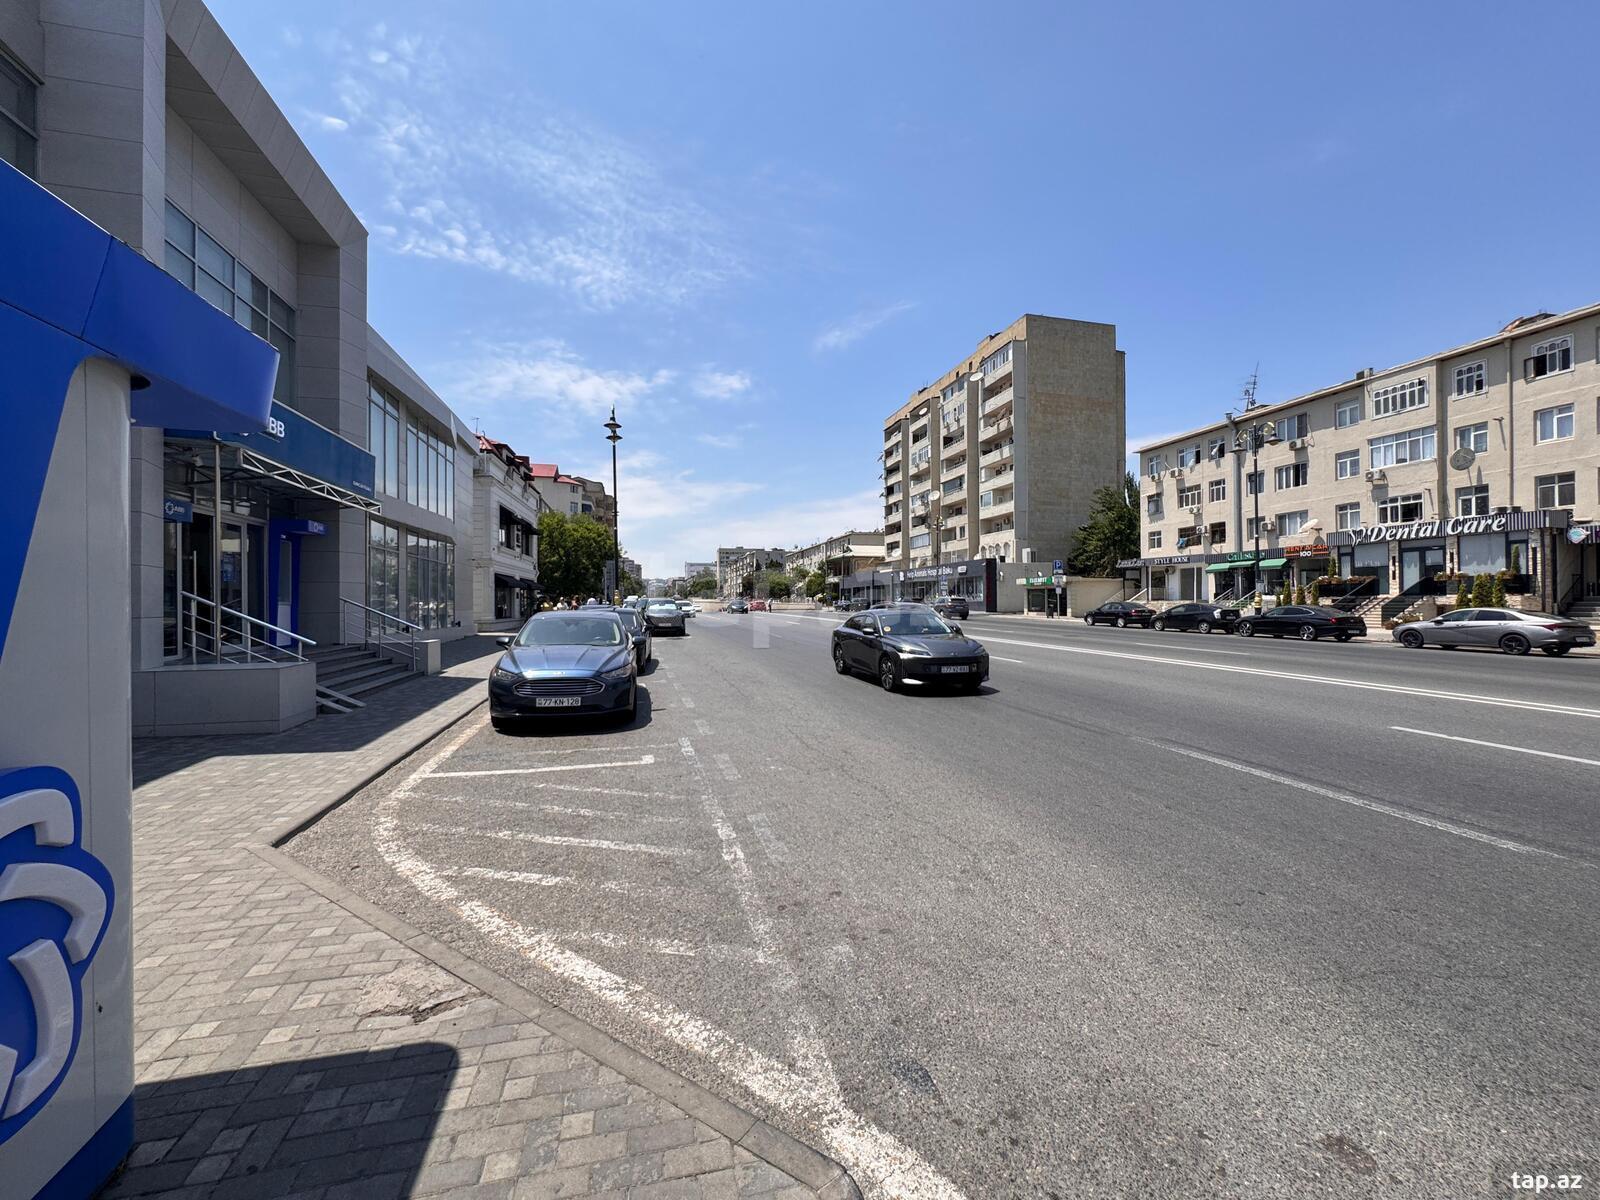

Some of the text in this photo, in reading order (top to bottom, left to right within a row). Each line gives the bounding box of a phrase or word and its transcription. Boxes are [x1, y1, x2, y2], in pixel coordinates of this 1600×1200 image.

[267, 416, 285, 438] BB
[1367, 515, 1506, 542] Dental Care
